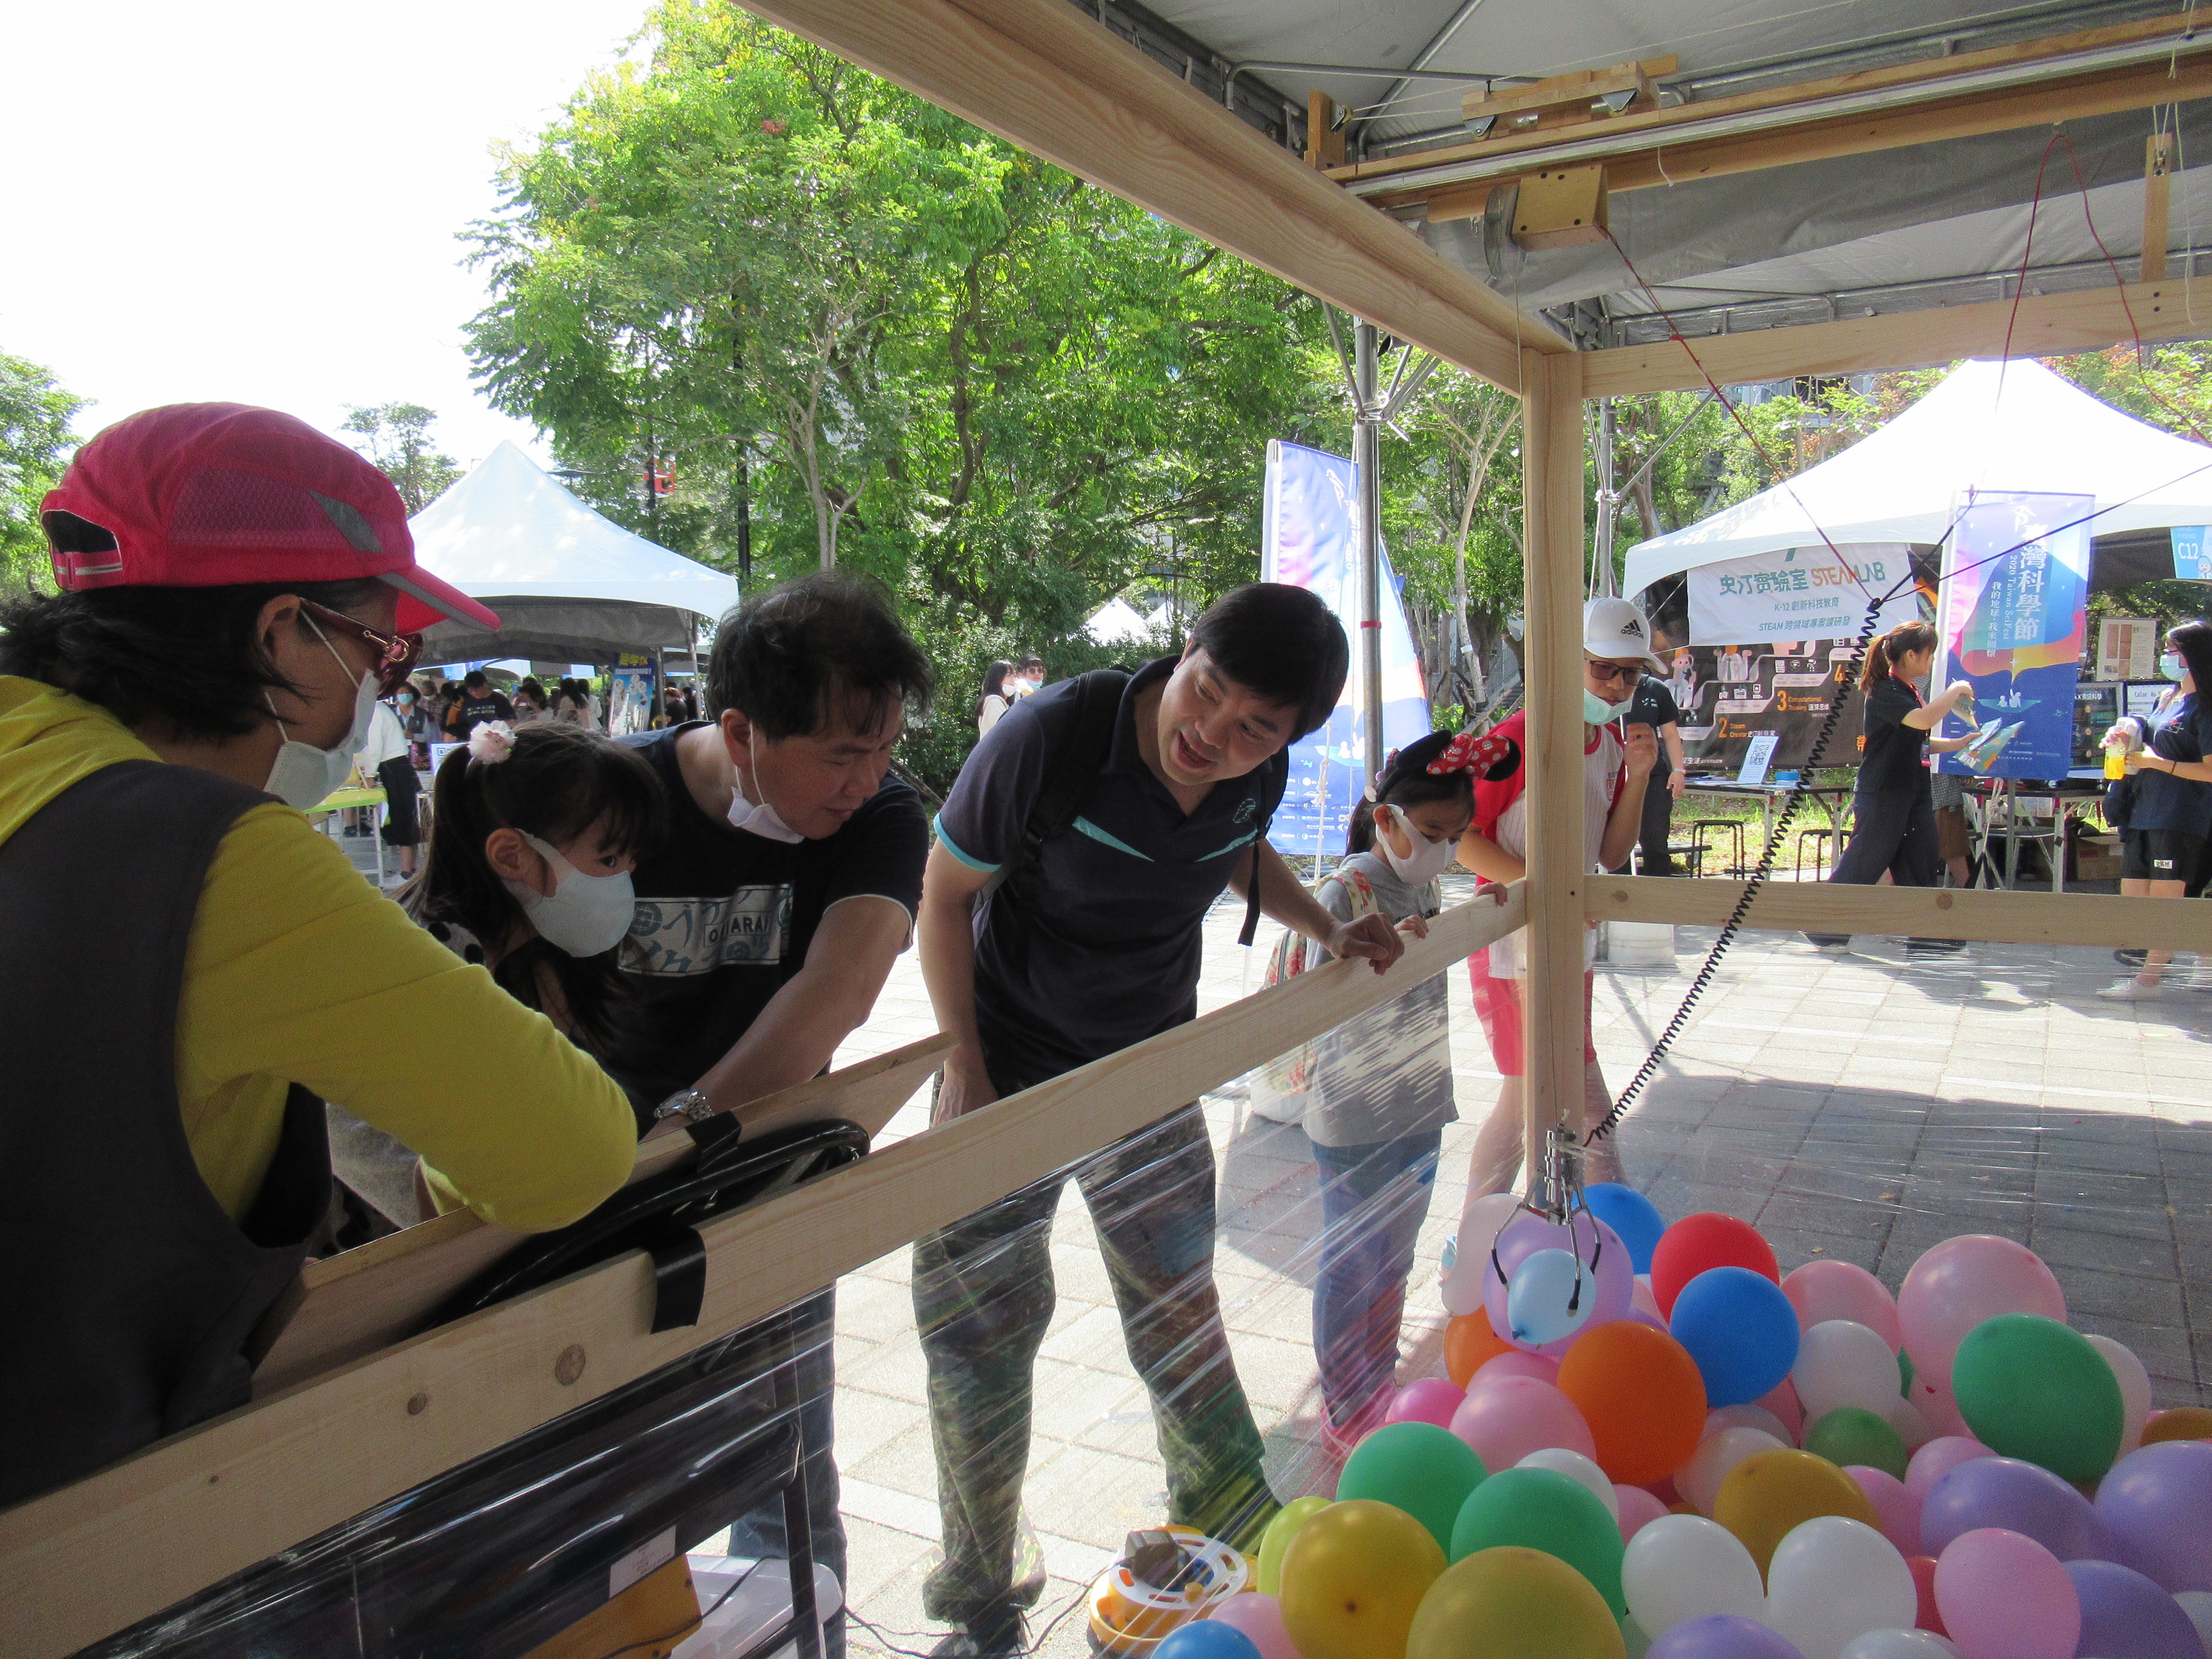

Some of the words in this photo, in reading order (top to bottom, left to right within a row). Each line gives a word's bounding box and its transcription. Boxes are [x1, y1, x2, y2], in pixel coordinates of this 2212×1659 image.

[2178, 542, 2199, 559] C12
[2008, 555, 2017, 575] 2020
[1719, 568, 1809, 596] 史汀實驗室
[2005, 577, 2016, 607] Taiwan
[1774, 602, 1789, 611] K-12
[1792, 597, 1839, 611] 創新科技教育
[1621, 629, 1644, 639] adidas
[1759, 623, 1783, 631] STEAM
[1777, 690, 1788, 711] 3
[1718, 717, 1728, 738] 2
